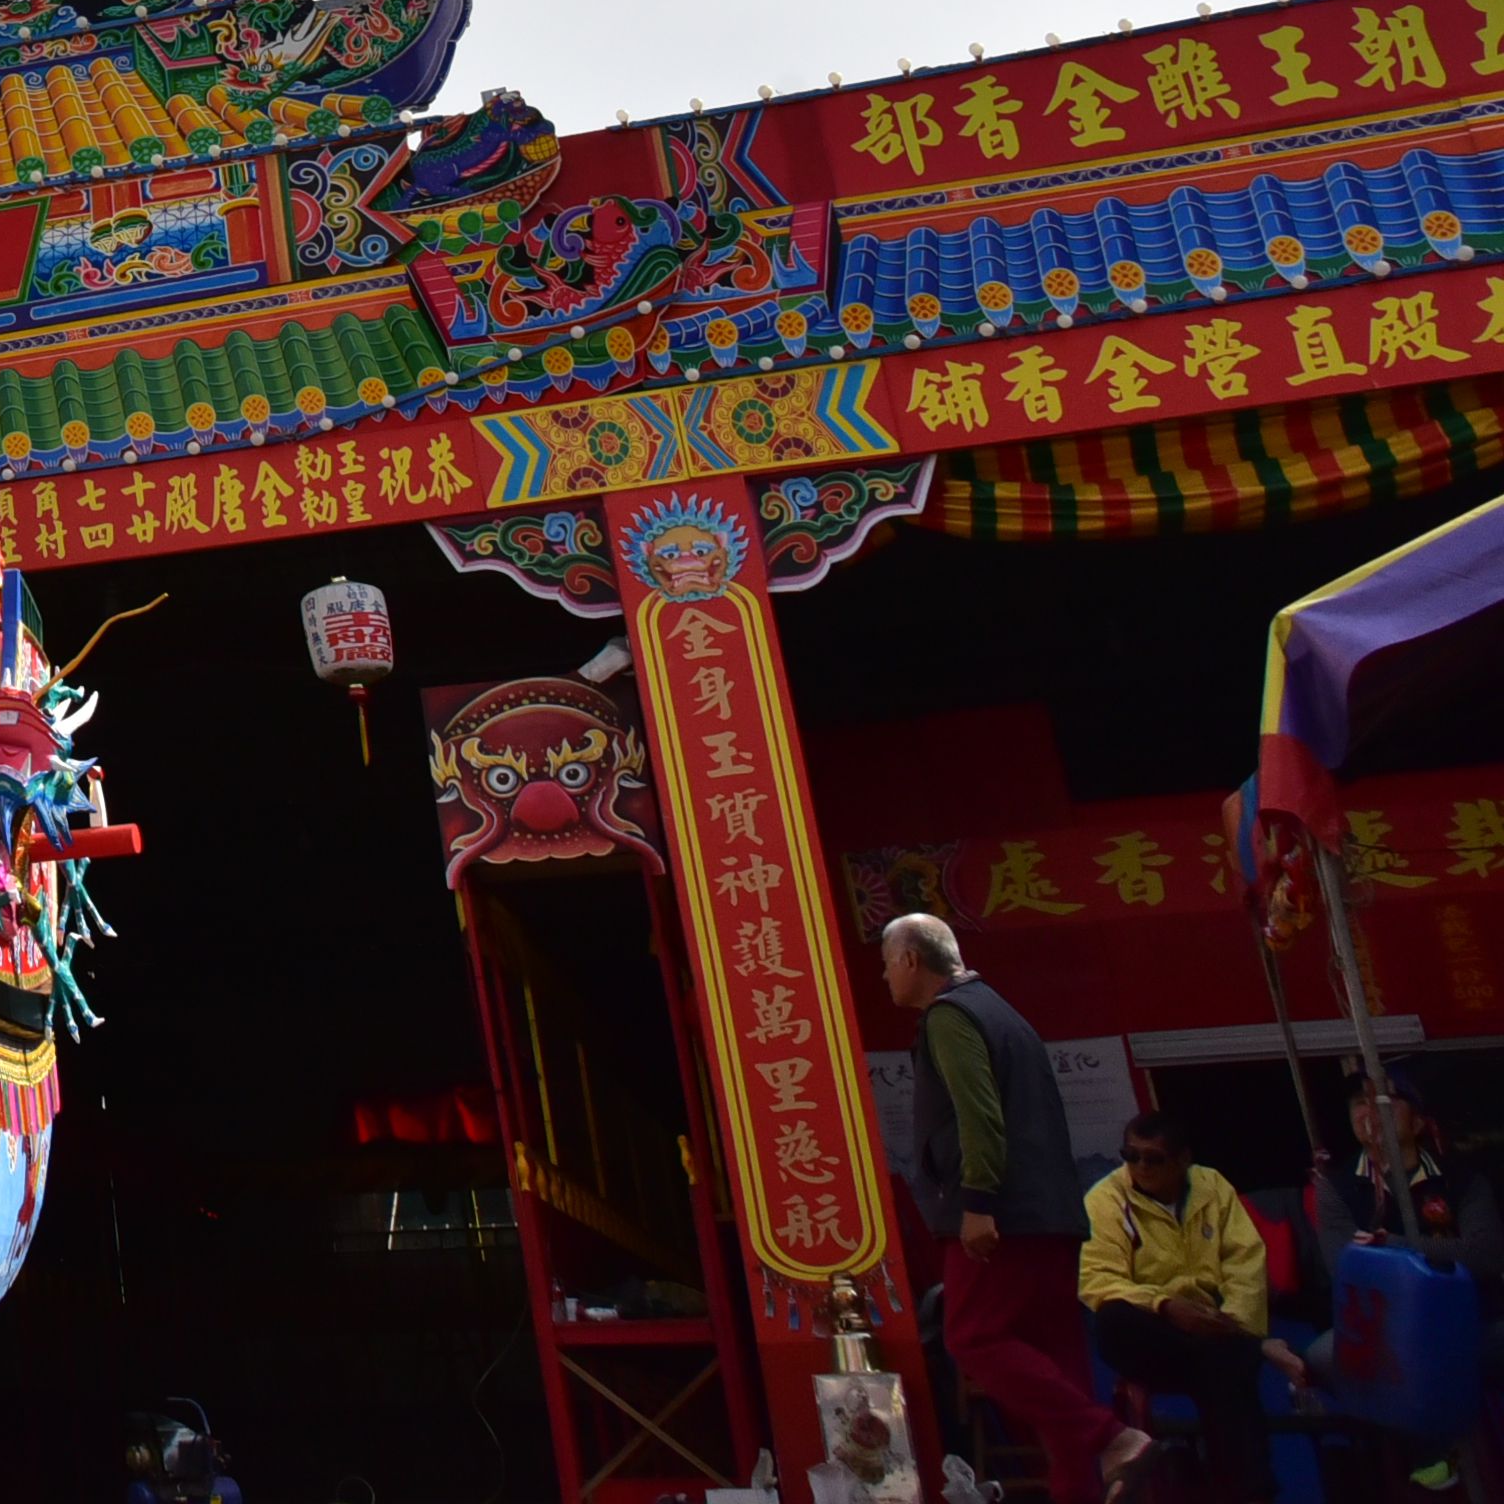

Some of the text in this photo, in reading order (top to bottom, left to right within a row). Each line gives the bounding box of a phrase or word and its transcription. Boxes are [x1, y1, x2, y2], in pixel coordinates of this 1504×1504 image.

[165, 460, 294, 535] 金唐殿
[377, 432, 473, 507] 恭祝
[665, 606, 861, 1255] 金身玉質神護萬里慈航
